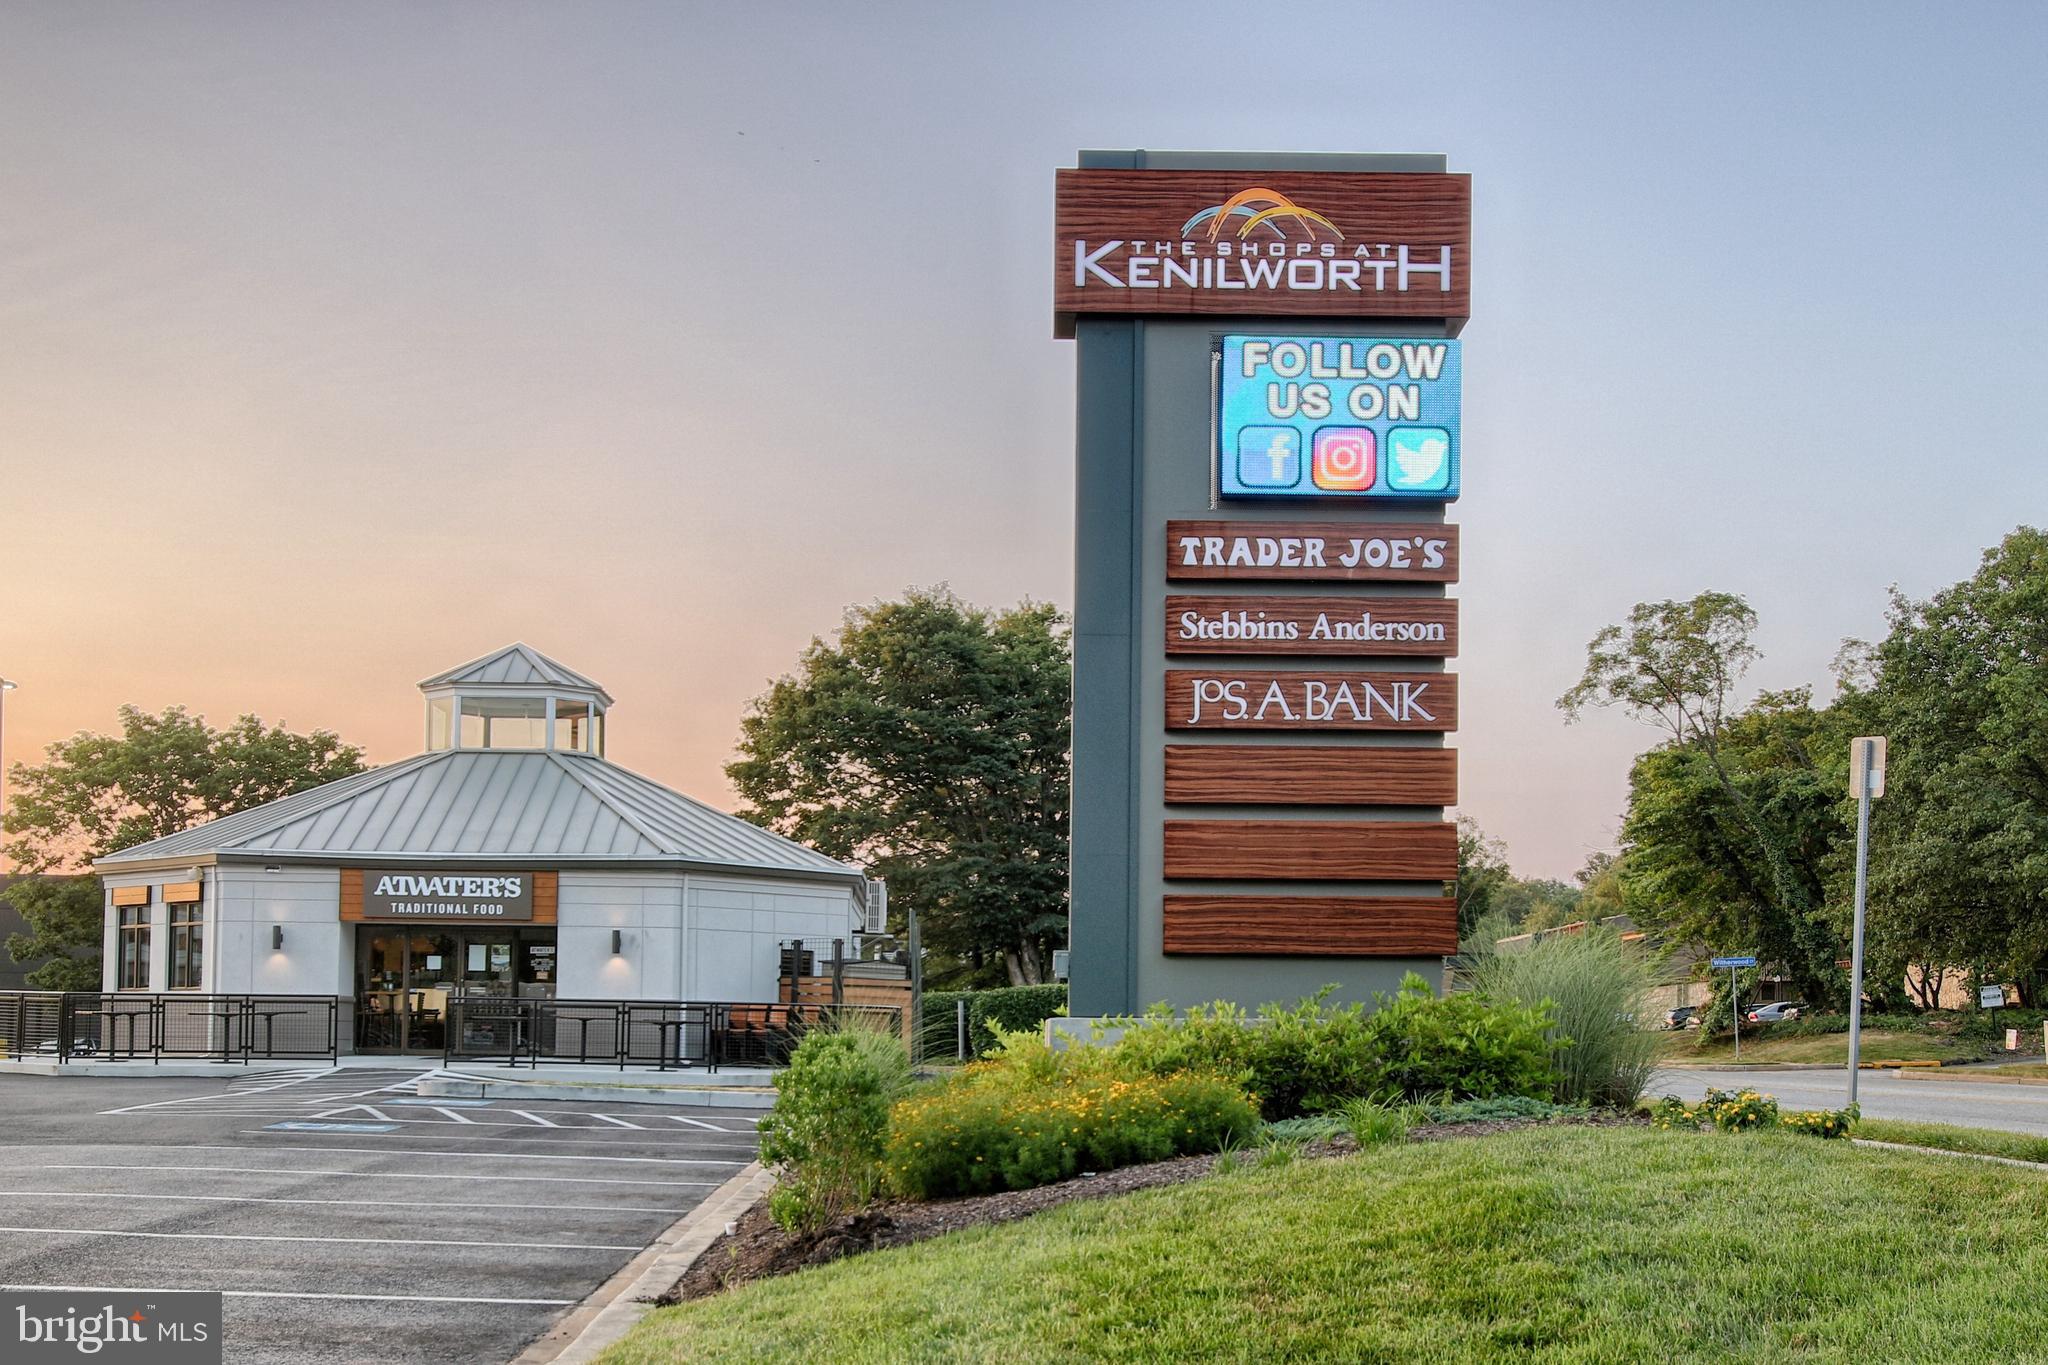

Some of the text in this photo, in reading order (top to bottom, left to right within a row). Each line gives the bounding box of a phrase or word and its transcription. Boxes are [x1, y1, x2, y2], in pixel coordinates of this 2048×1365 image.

[1131, 240, 1391, 258] THE SHOPS AT
[1075, 239, 1451, 292] KENILWORTH
[1242, 342, 1446, 379] FOLLOW
[1267, 383, 1420, 420] US ON
[1179, 536, 1447, 568] TRADER JOE'S
[1180, 611, 1445, 641] Stebbins Anderson
[1304, 681, 1437, 722] BANK
[373, 875, 521, 898] ATWATER'S
[391, 902, 503, 915] TRADITIONAL FOOD
